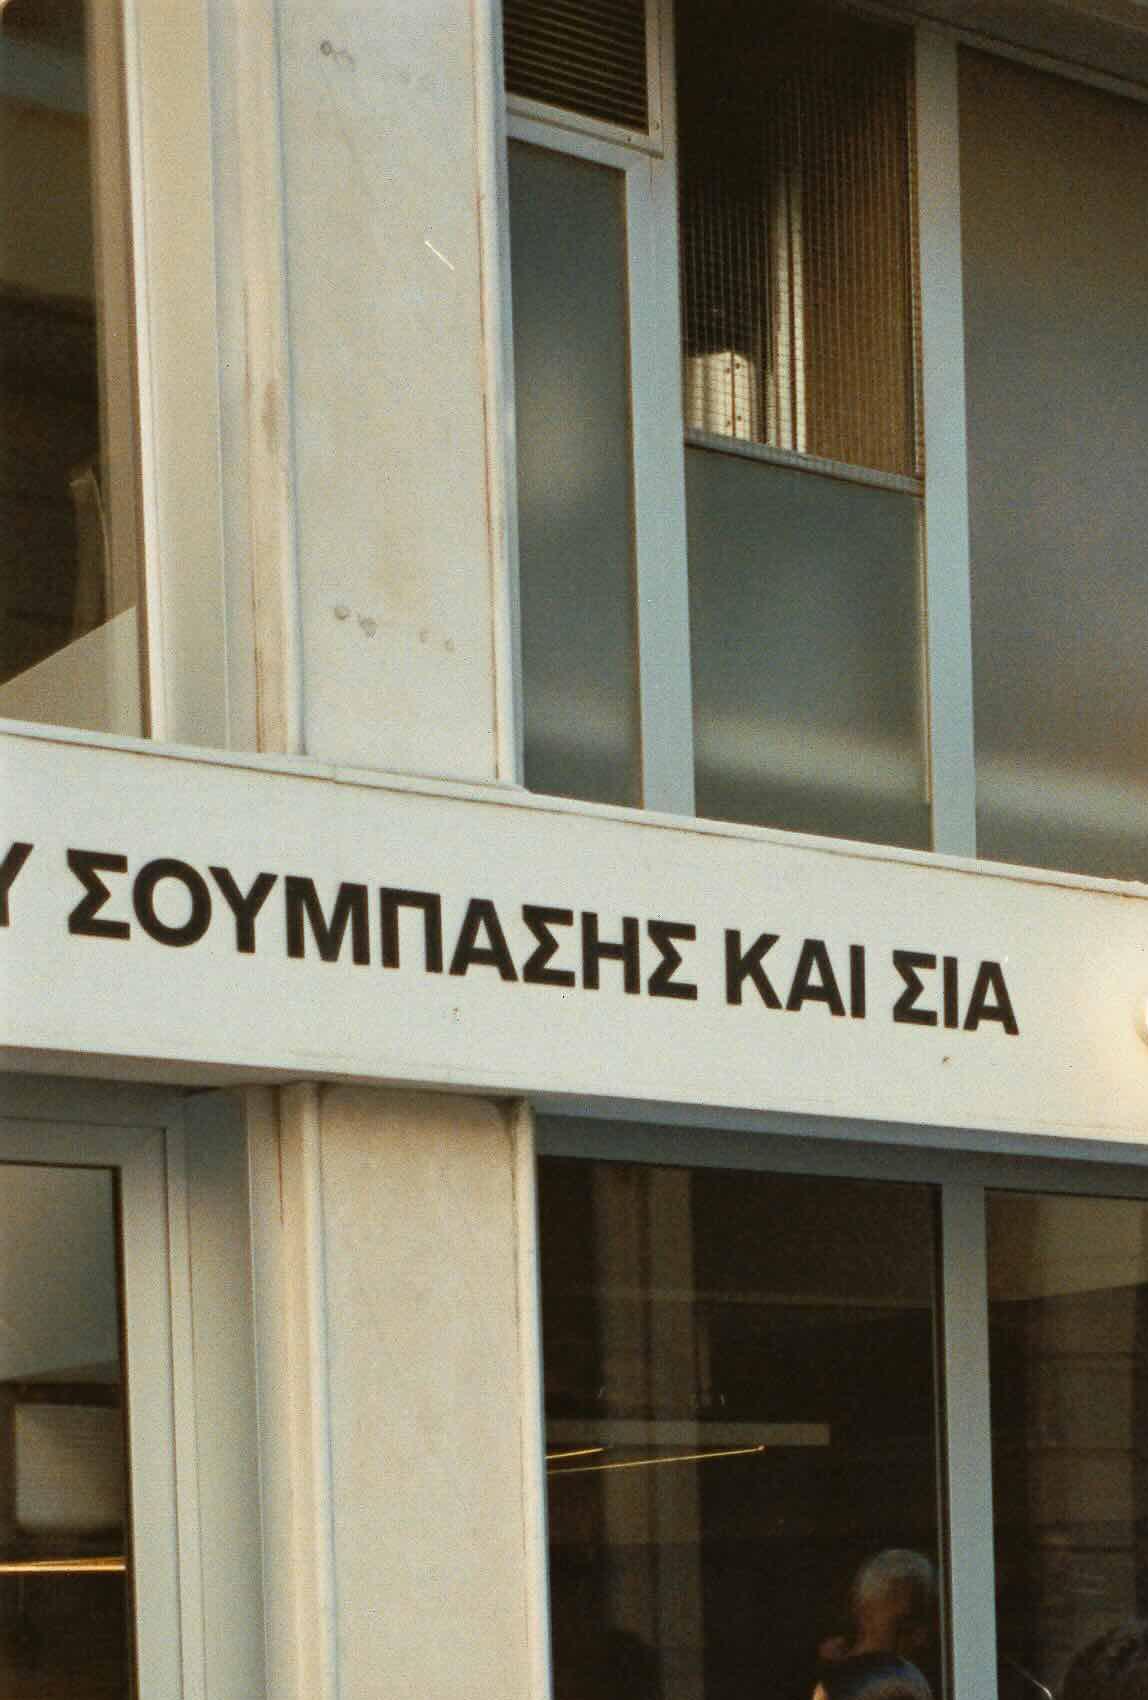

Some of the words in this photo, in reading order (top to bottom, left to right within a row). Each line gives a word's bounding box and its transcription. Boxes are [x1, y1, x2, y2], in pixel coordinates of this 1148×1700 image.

[66, 848, 698, 1001] ΣΟΥΜΠΑΣΗΣ
[724, 929, 866, 1019] ΚΑΙ
[892, 949, 1019, 1036] ΣΙΑ
